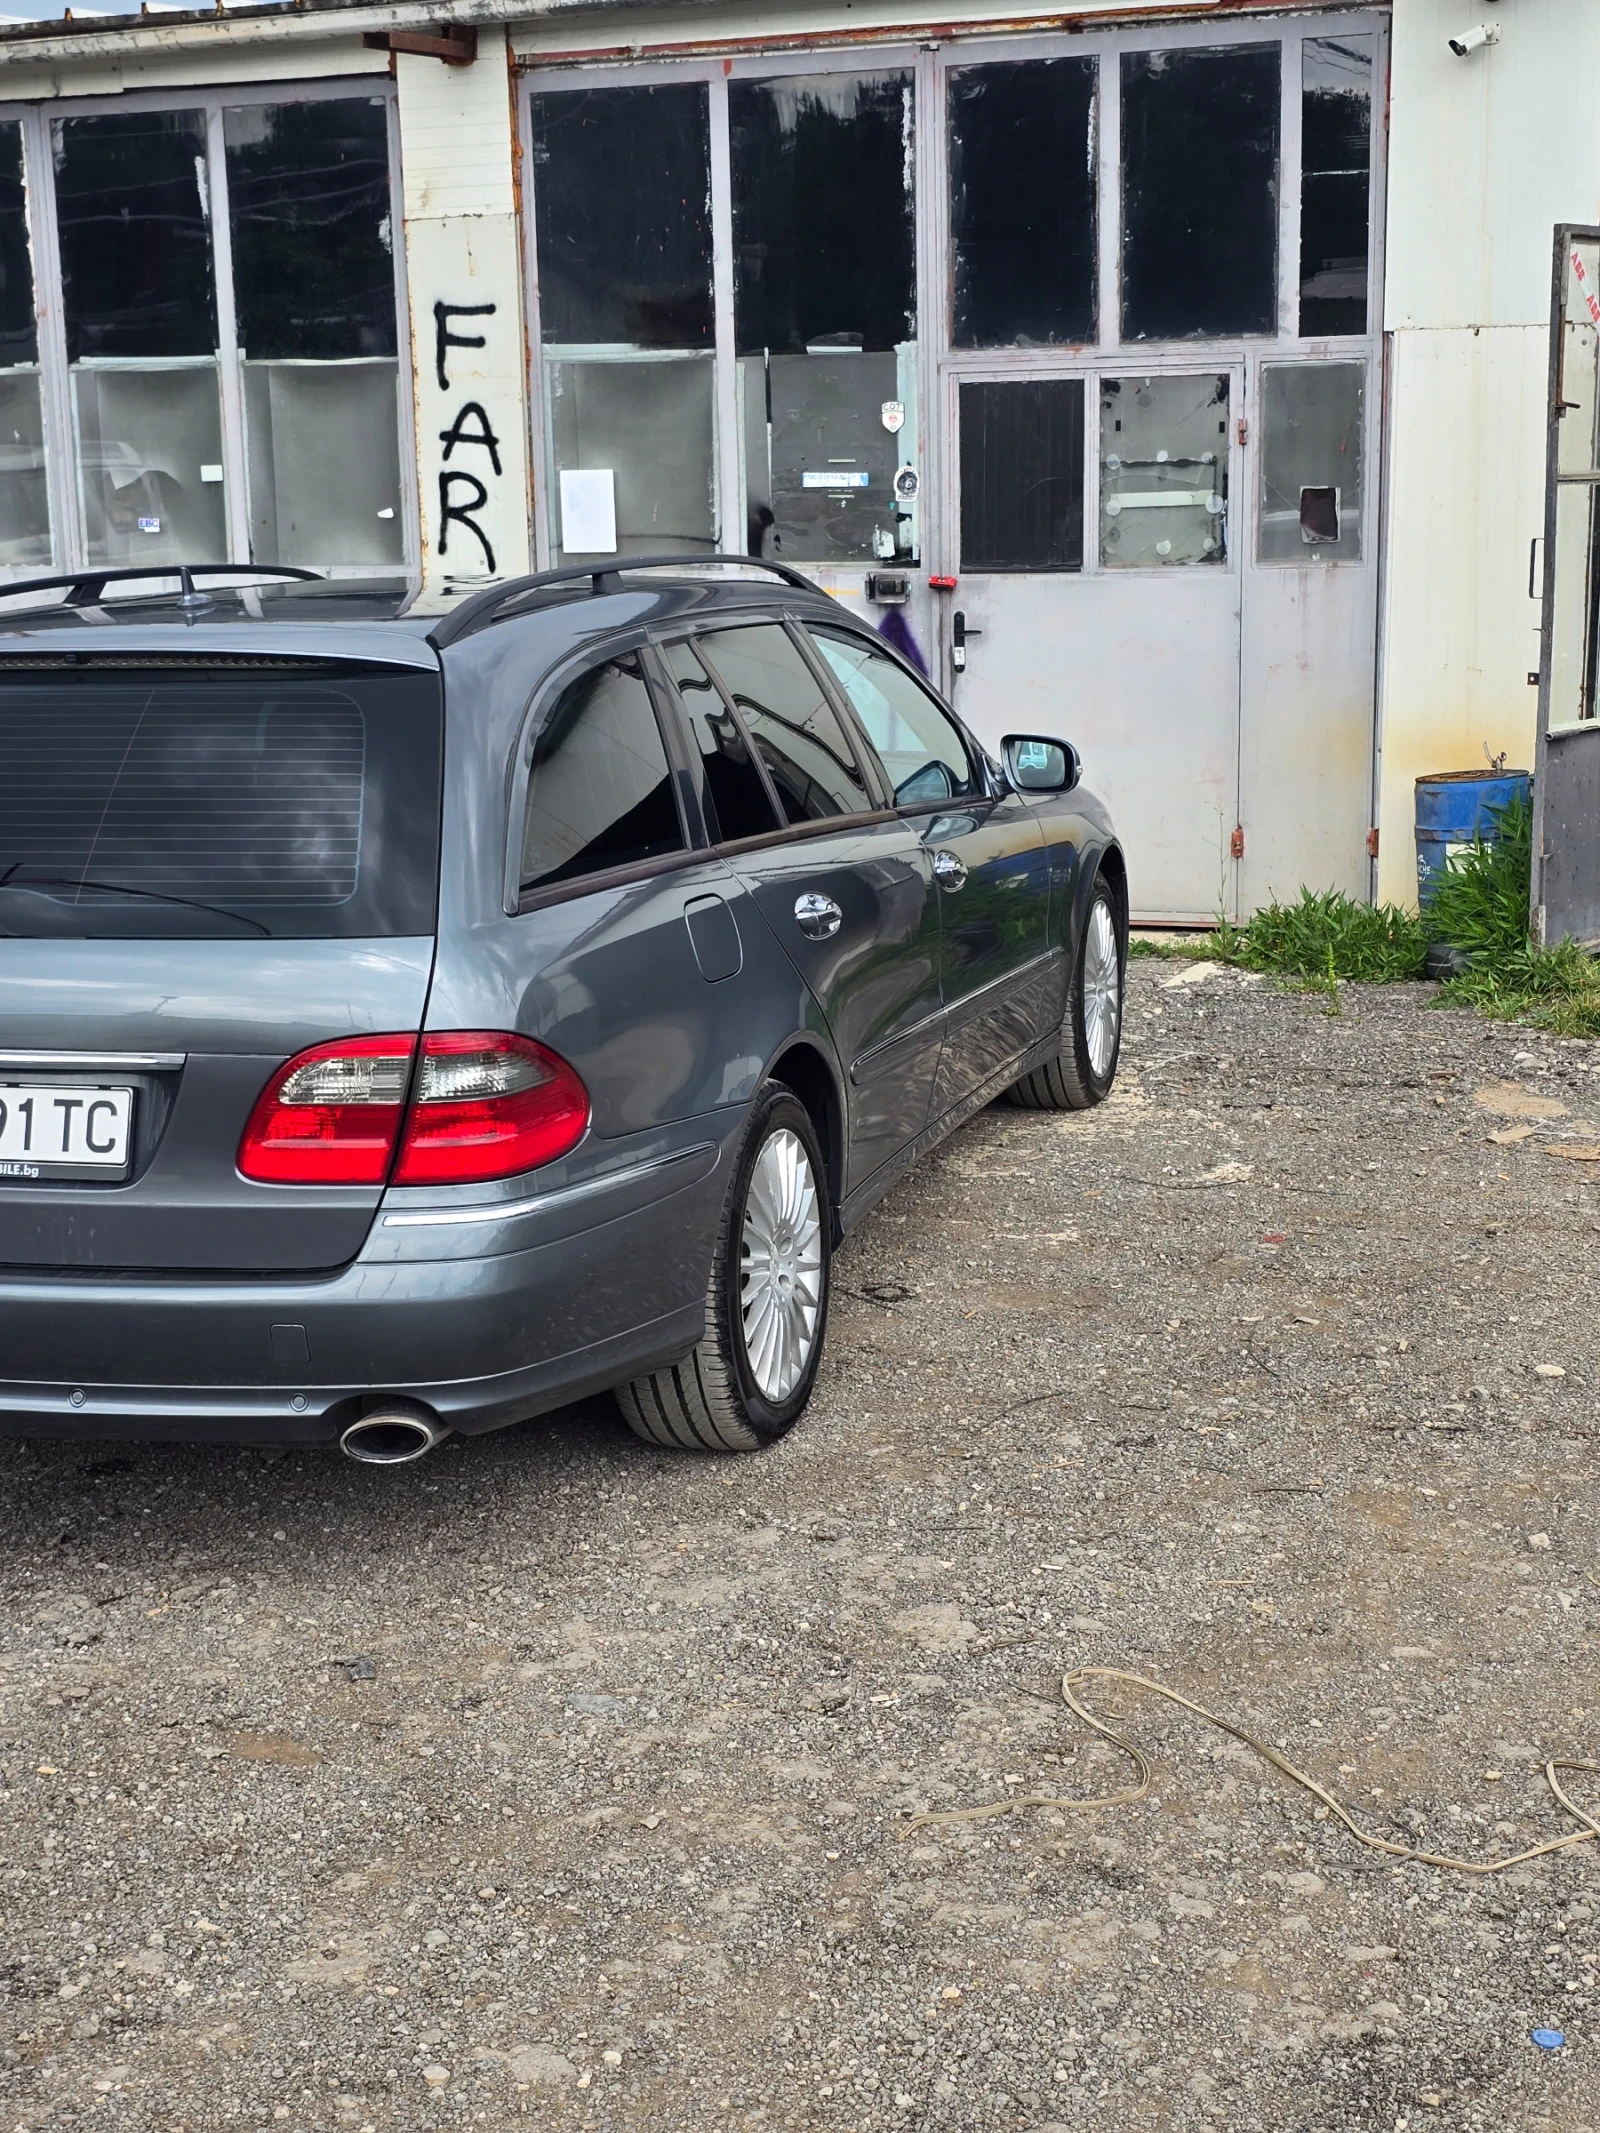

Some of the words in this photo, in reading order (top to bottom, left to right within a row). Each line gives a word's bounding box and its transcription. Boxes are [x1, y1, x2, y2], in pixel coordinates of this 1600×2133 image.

[1571, 252, 1585, 281] ABB
[434, 301, 502, 573] FAR
[0, 1098, 33, 1151] 1
[54, 1098, 118, 1153] TC
